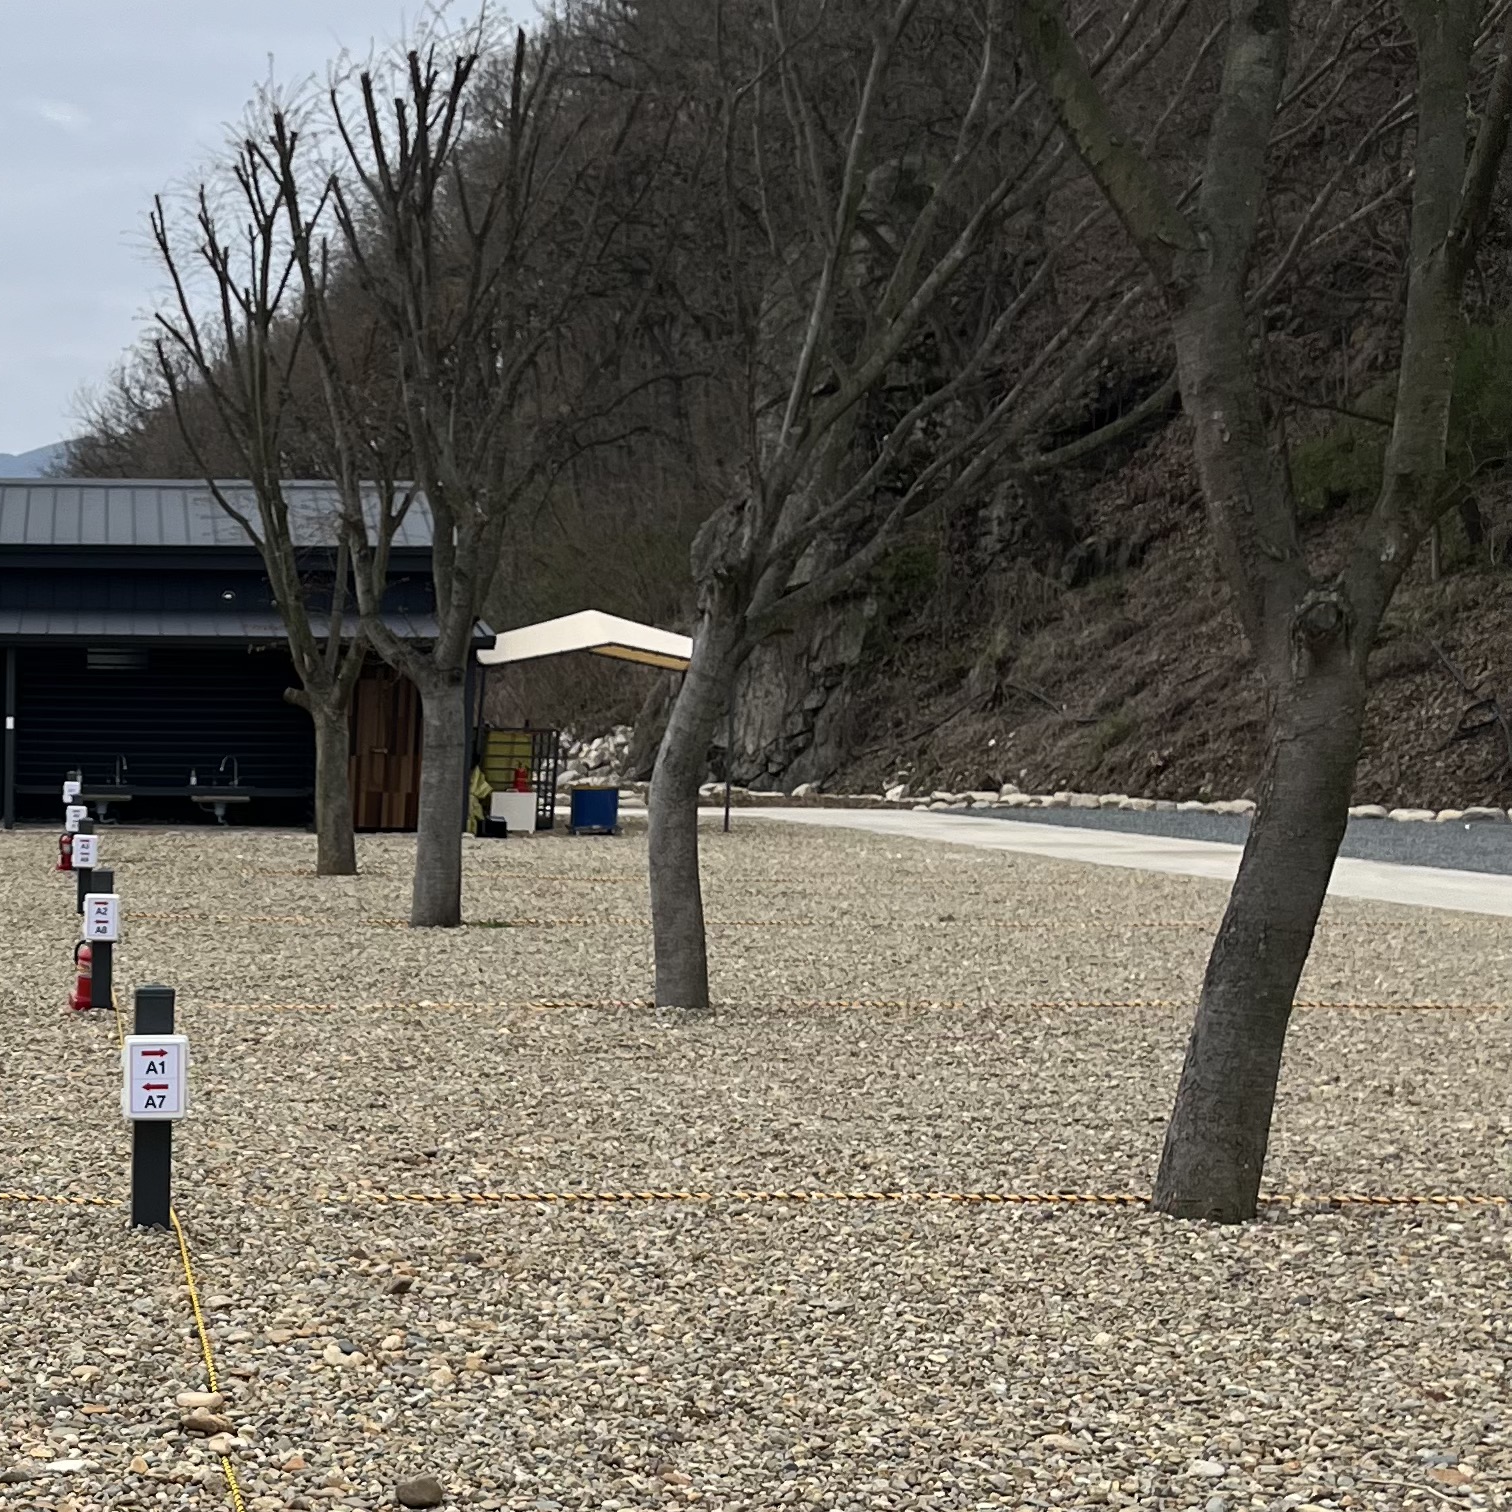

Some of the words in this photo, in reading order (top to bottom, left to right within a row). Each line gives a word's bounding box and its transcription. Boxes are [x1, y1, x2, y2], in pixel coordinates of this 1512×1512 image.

[95, 907, 108, 916] A2
[145, 1060, 166, 1075] A1
[144, 1095, 167, 1109] A7
